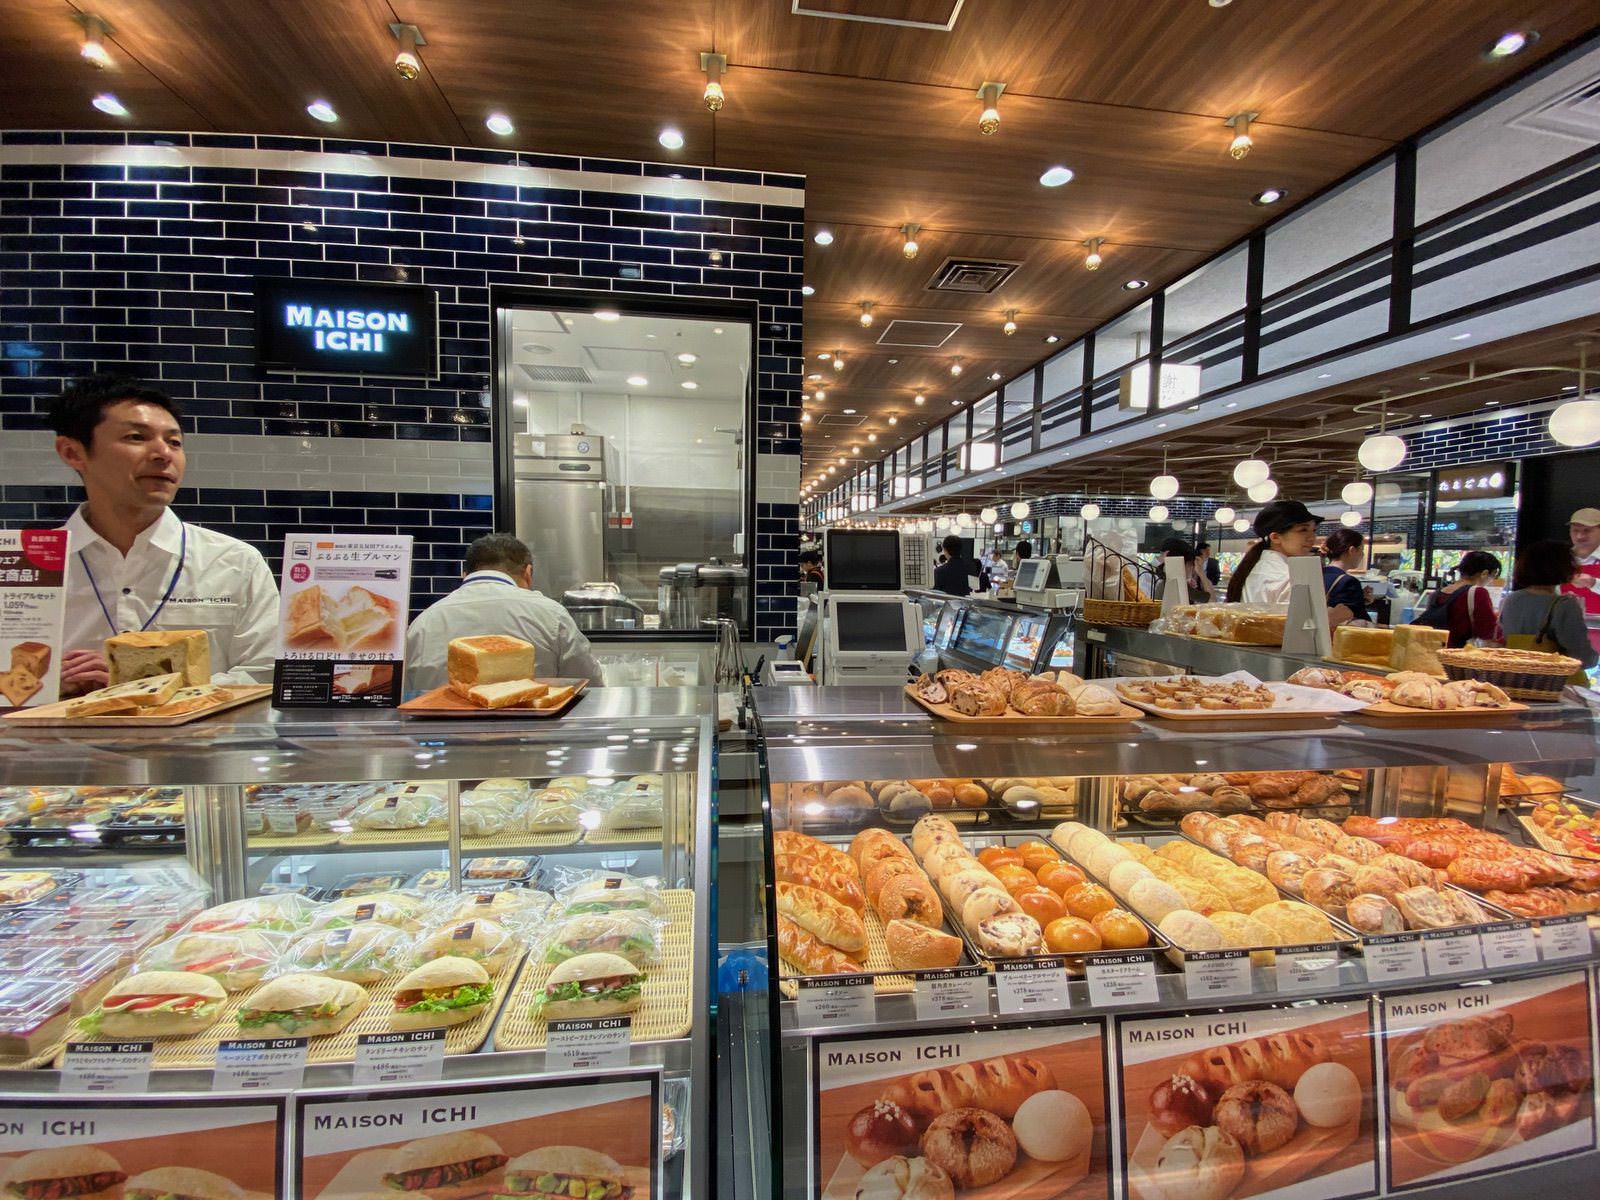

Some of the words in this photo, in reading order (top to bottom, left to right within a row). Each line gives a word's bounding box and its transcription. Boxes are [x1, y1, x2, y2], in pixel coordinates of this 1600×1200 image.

[286, 305, 408, 331] MAISON
[316, 331, 383, 352] ICHI
[1003, 963, 1034, 971] MAISON
[923, 972, 955, 980] MAISON
[807, 980, 840, 988] MAISON
[1391, 999, 1447, 1017] MAISON
[1457, 994, 1490, 1009] ICHI
[557, 1023, 593, 1031] MAISON
[599, 1019, 621, 1028] ICHI
[367, 1035, 405, 1043] MAISON
[411, 1032, 435, 1040] ICHI
[1129, 1028, 1195, 1043] MAISON
[1208, 1021, 1247, 1036] ICHI
[76, 1044, 112, 1052] MAISON
[118, 1044, 143, 1052] ICHI
[228, 1041, 266, 1049] MAISON
[272, 1039, 297, 1048] ICHI
[827, 1050, 902, 1066] MAISON
[916, 1044, 961, 1060] ICHI
[314, 1113, 403, 1130] MAISON
[422, 1105, 477, 1123] ICHI
[42, 1121, 95, 1135] ICHI
